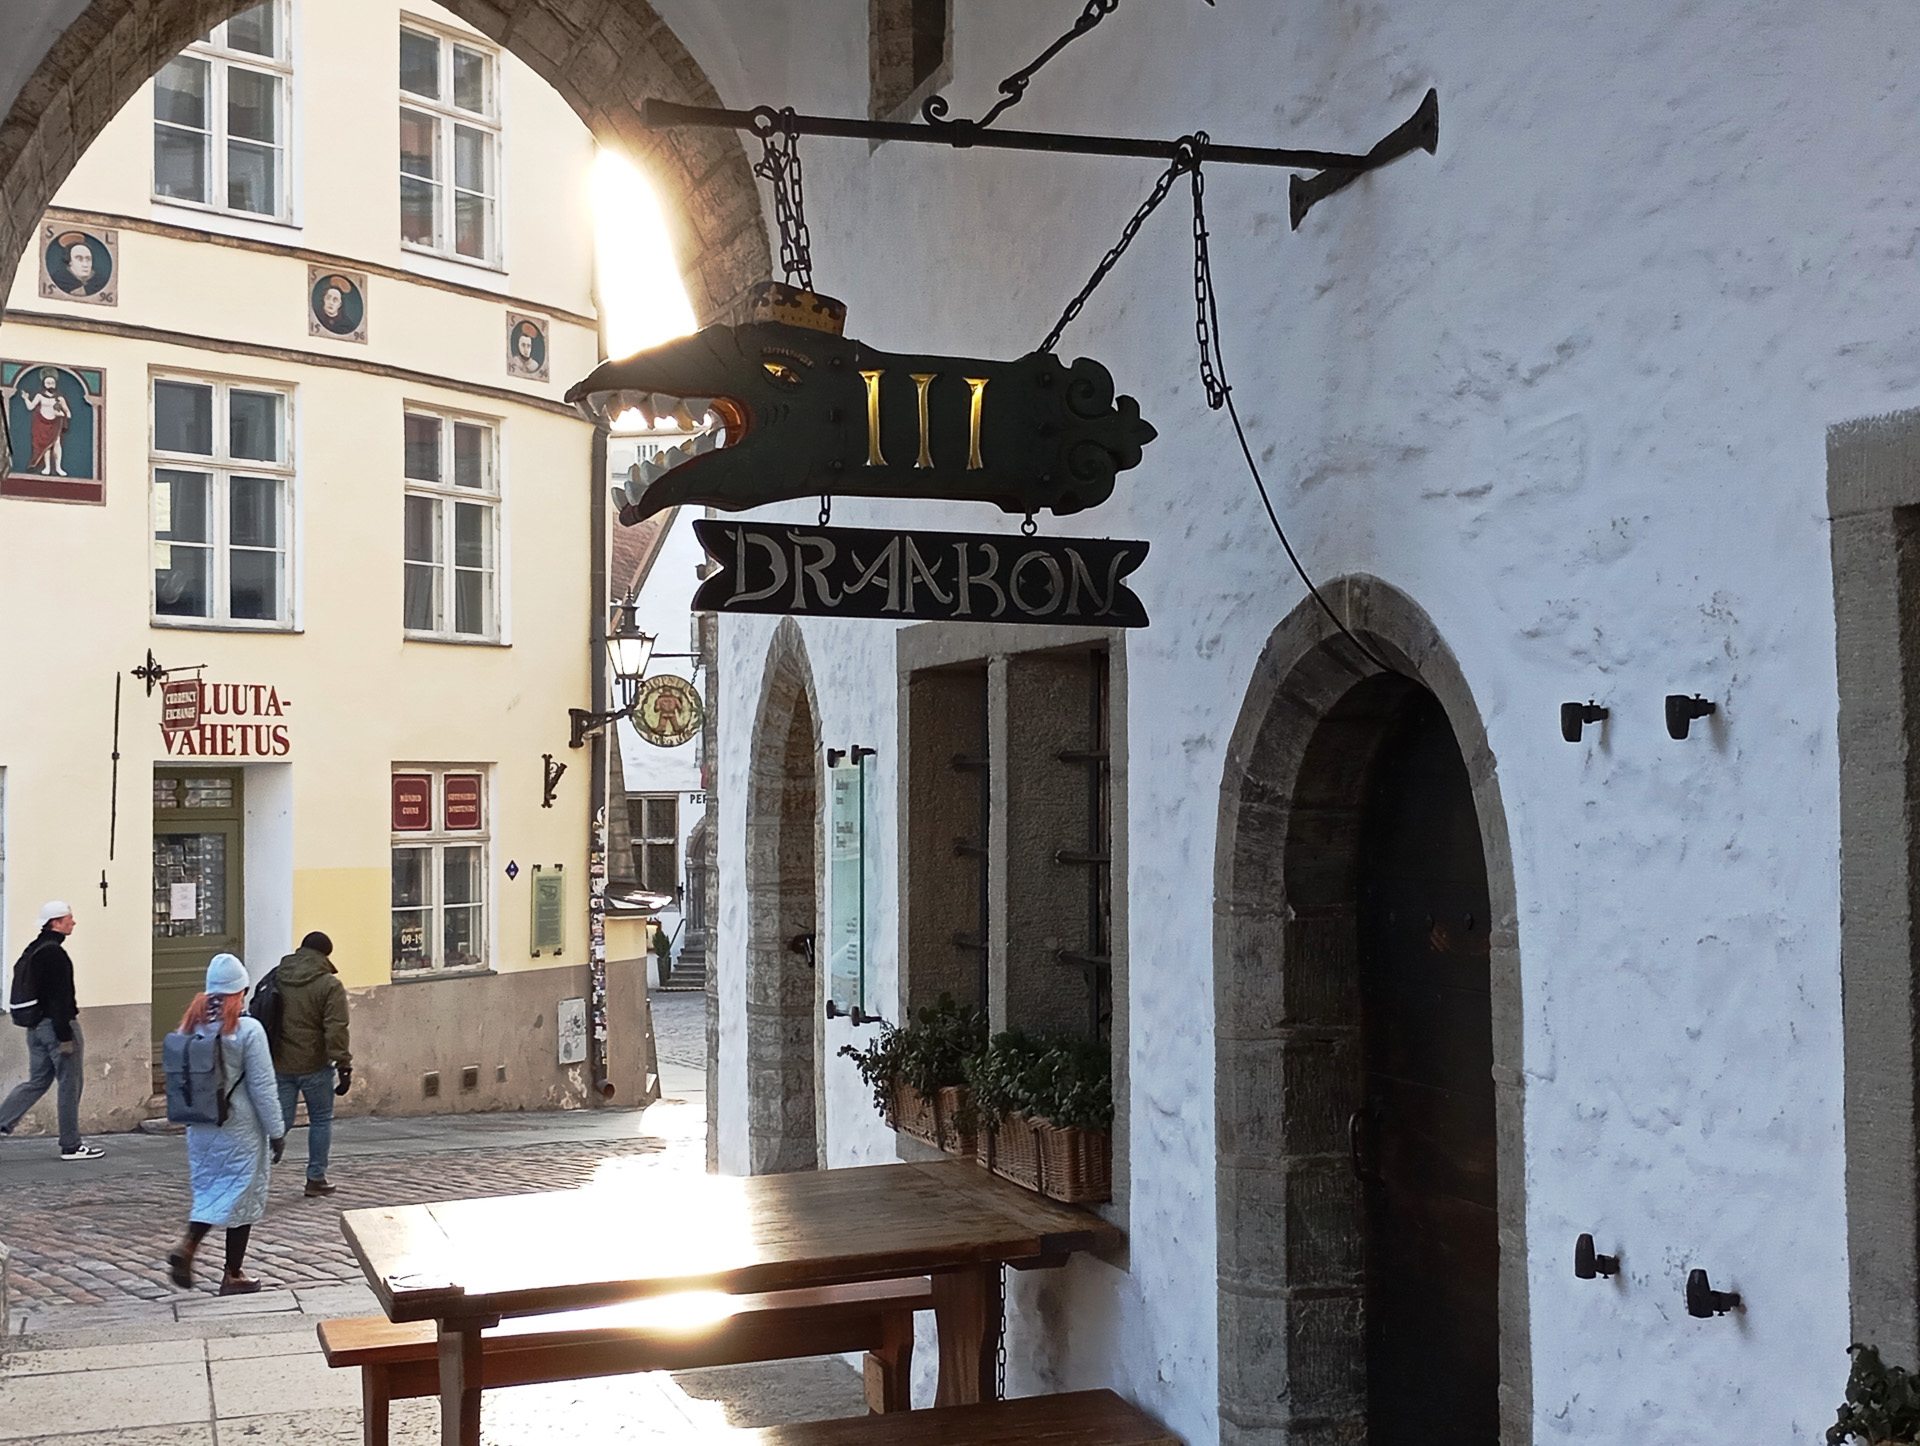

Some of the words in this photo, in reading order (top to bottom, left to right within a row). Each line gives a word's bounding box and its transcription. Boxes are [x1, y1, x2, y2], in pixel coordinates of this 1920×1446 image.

[45, 225, 54, 239] S
[105, 232, 114, 245] L
[42, 282, 56, 295] 15
[100, 292, 114, 303] 96
[311, 322, 321, 333] 15
[353, 331, 365, 341] 96
[858, 368, 990, 471] III
[723, 524, 1130, 618] DRAAKON
[160, 682, 291, 716] LUUTA-
[159, 723, 290, 756] VAHETUS
